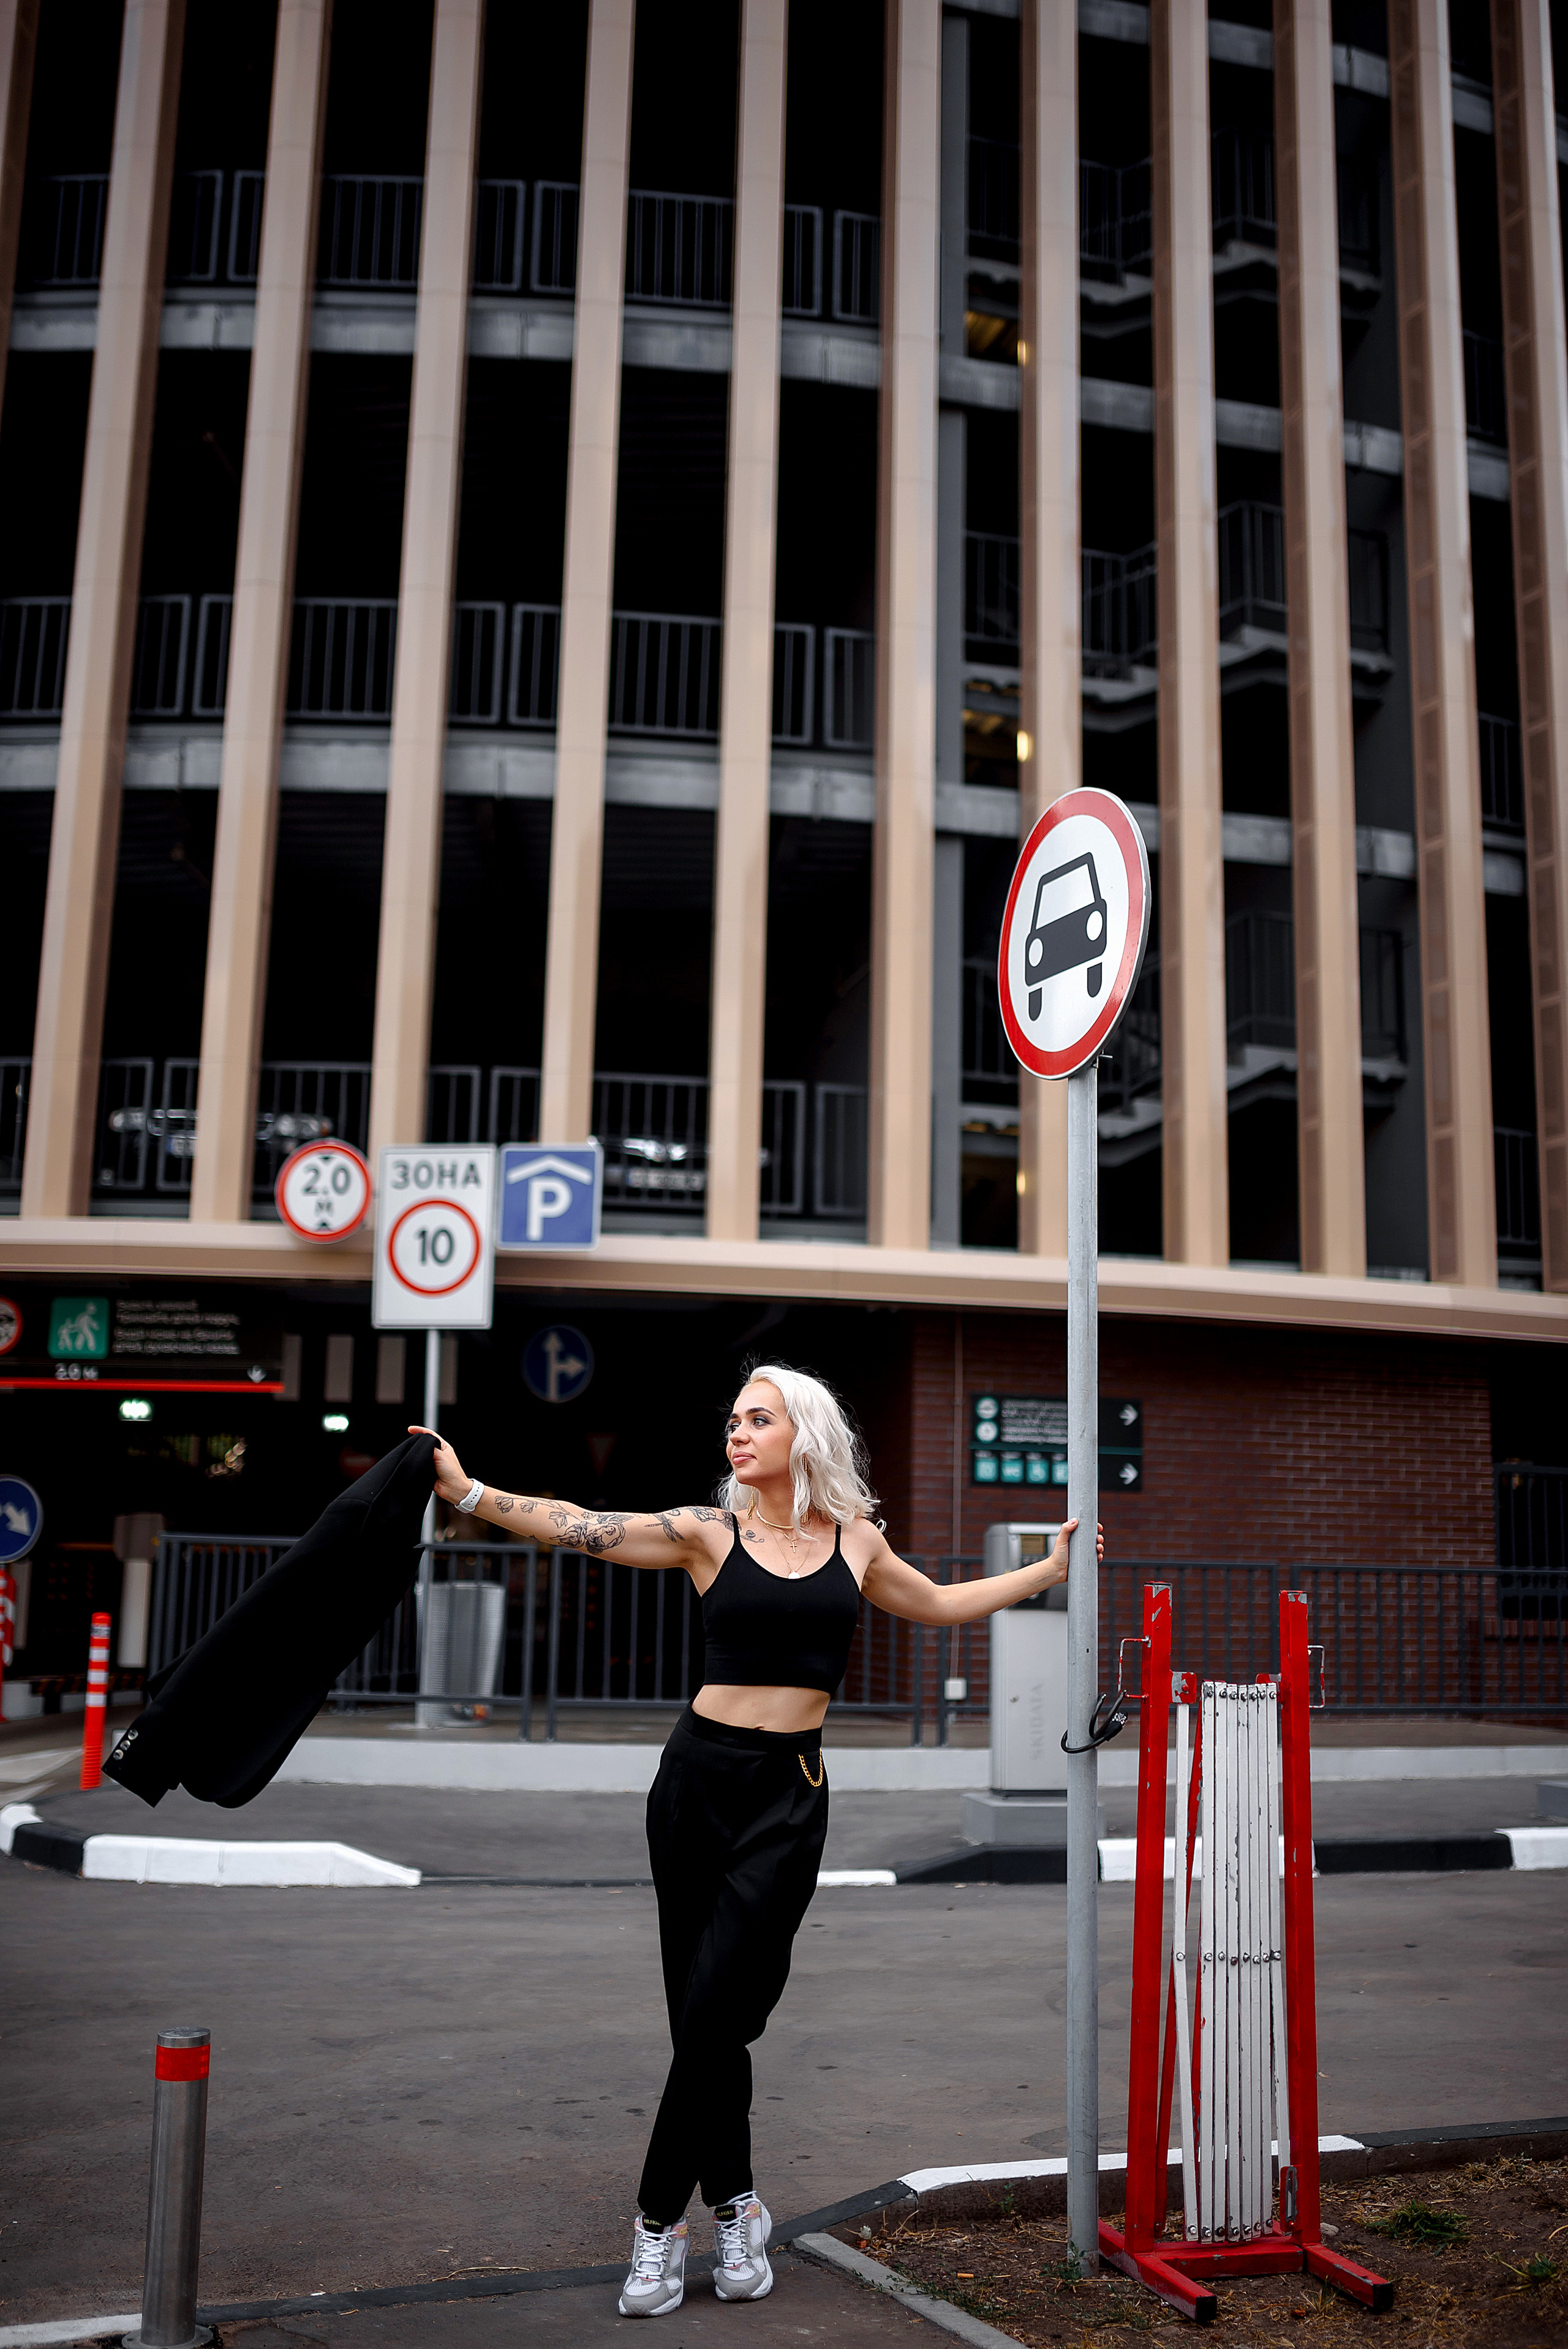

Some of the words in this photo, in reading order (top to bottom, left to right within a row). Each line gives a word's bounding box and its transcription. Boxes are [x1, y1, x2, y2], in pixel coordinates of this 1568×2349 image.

[303, 1165, 351, 1196] 2.0
[392, 1160, 481, 1189] ЗОНА
[526, 1176, 573, 1241] P
[417, 1227, 454, 1266] 10
